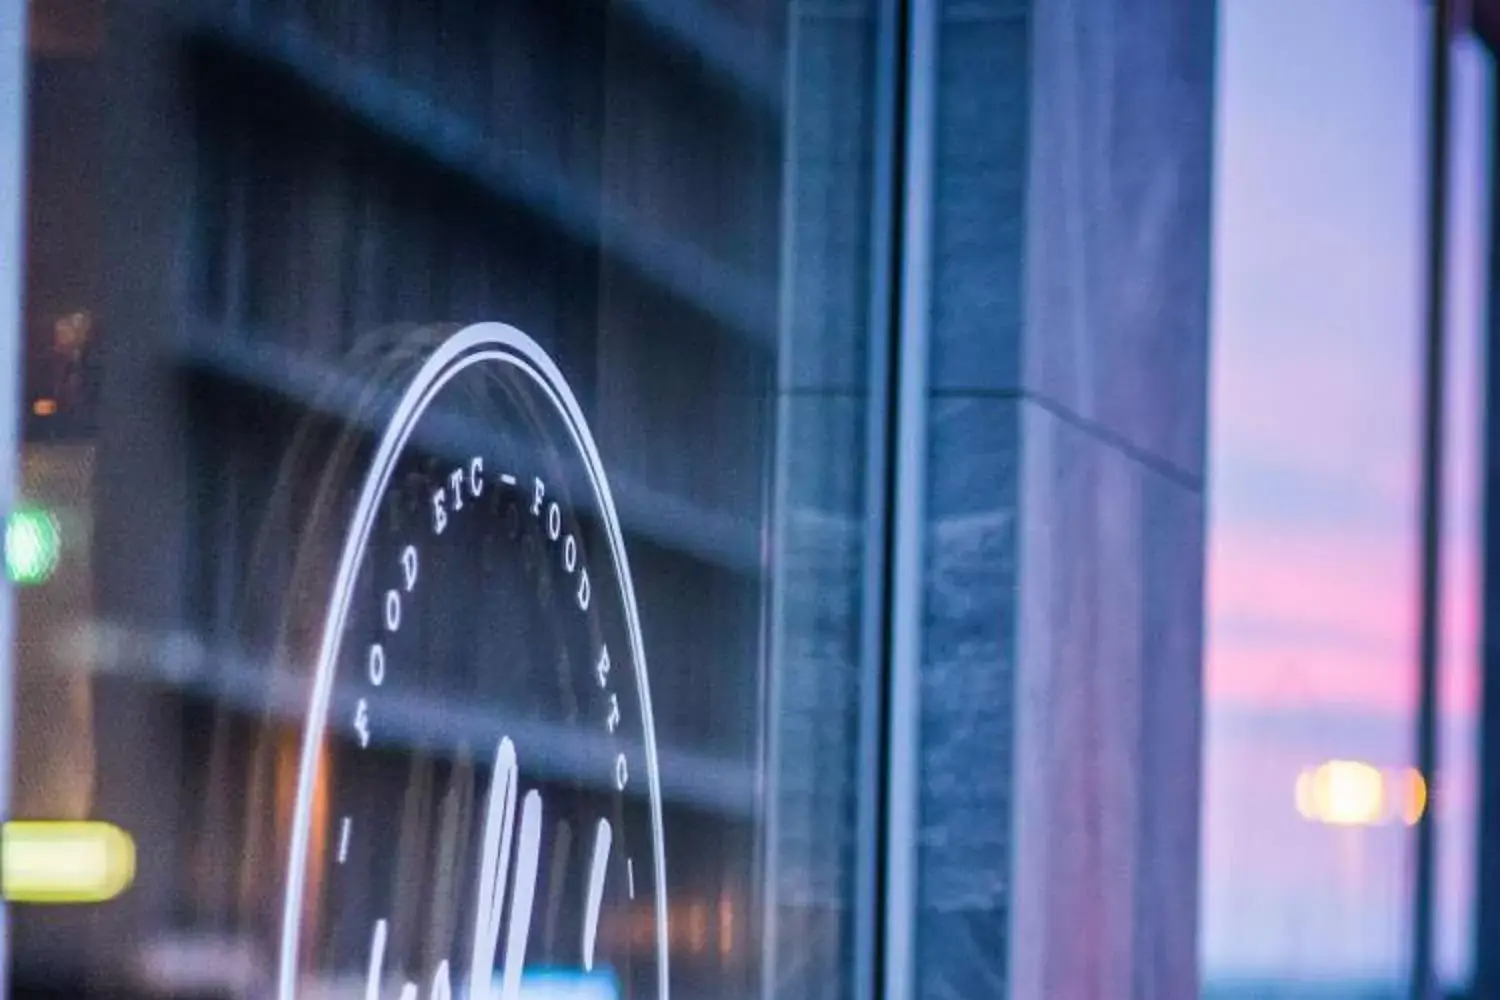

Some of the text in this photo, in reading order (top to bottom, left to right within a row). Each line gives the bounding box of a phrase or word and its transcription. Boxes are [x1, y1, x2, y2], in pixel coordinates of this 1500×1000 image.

[353, 544, 419, 750] FOOD
[432, 455, 484, 536] ETC
[529, 475, 592, 612] FOOD
